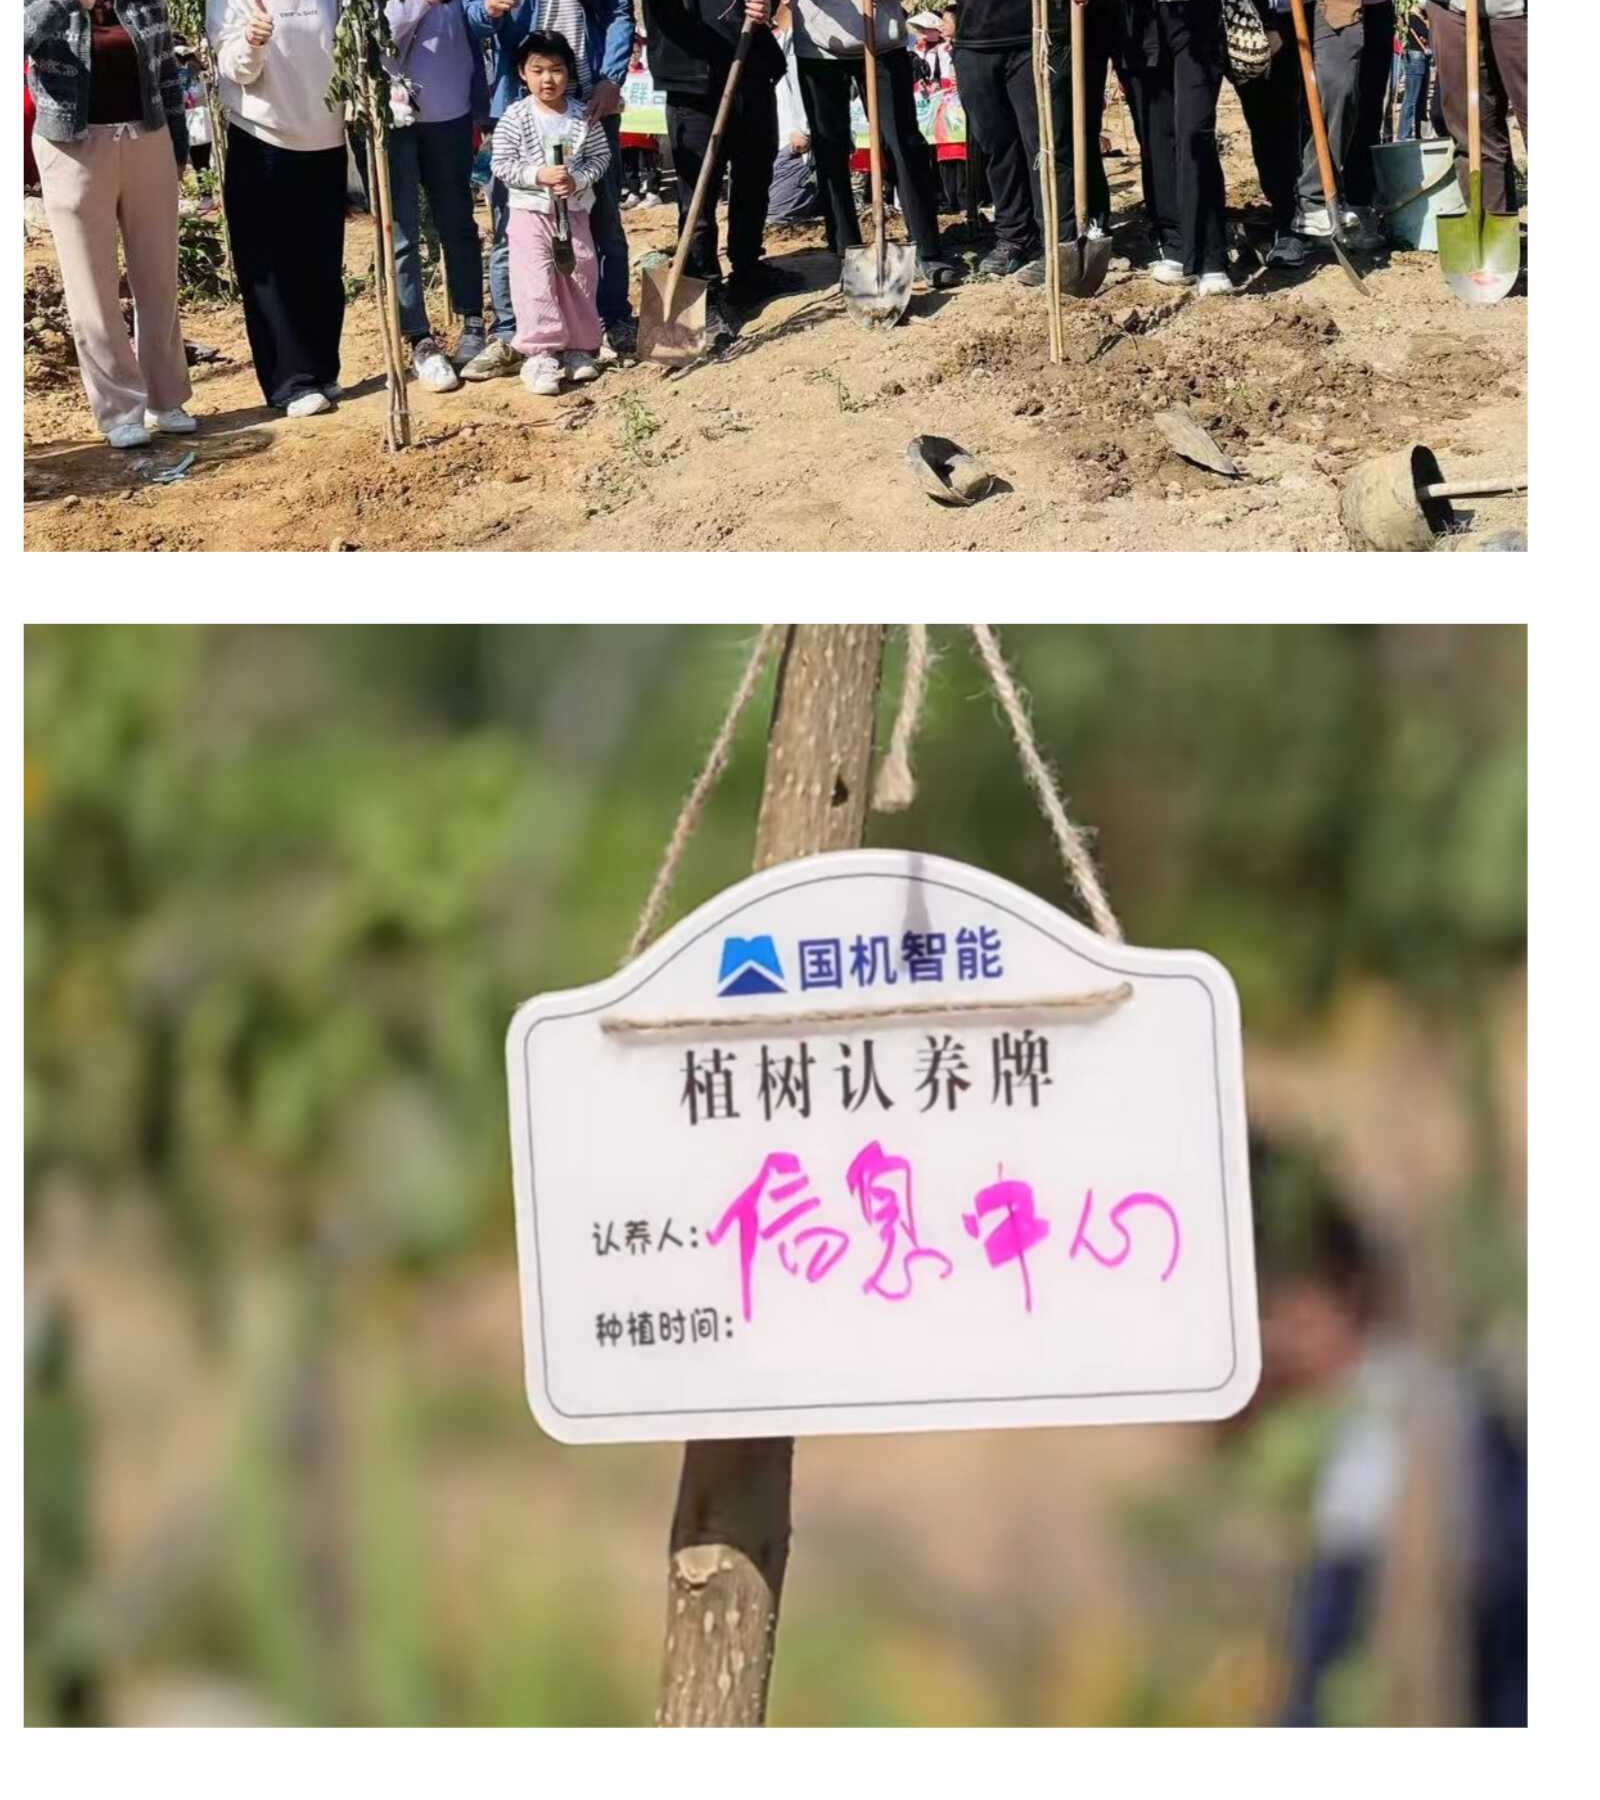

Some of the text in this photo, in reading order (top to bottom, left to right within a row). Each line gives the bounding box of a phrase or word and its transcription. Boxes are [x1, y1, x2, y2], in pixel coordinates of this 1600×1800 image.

[798, 926, 1005, 992] 国机智能
[679, 1028, 1055, 1126] 植树认养牌
[706, 1138, 1185, 1323] 信息中心
